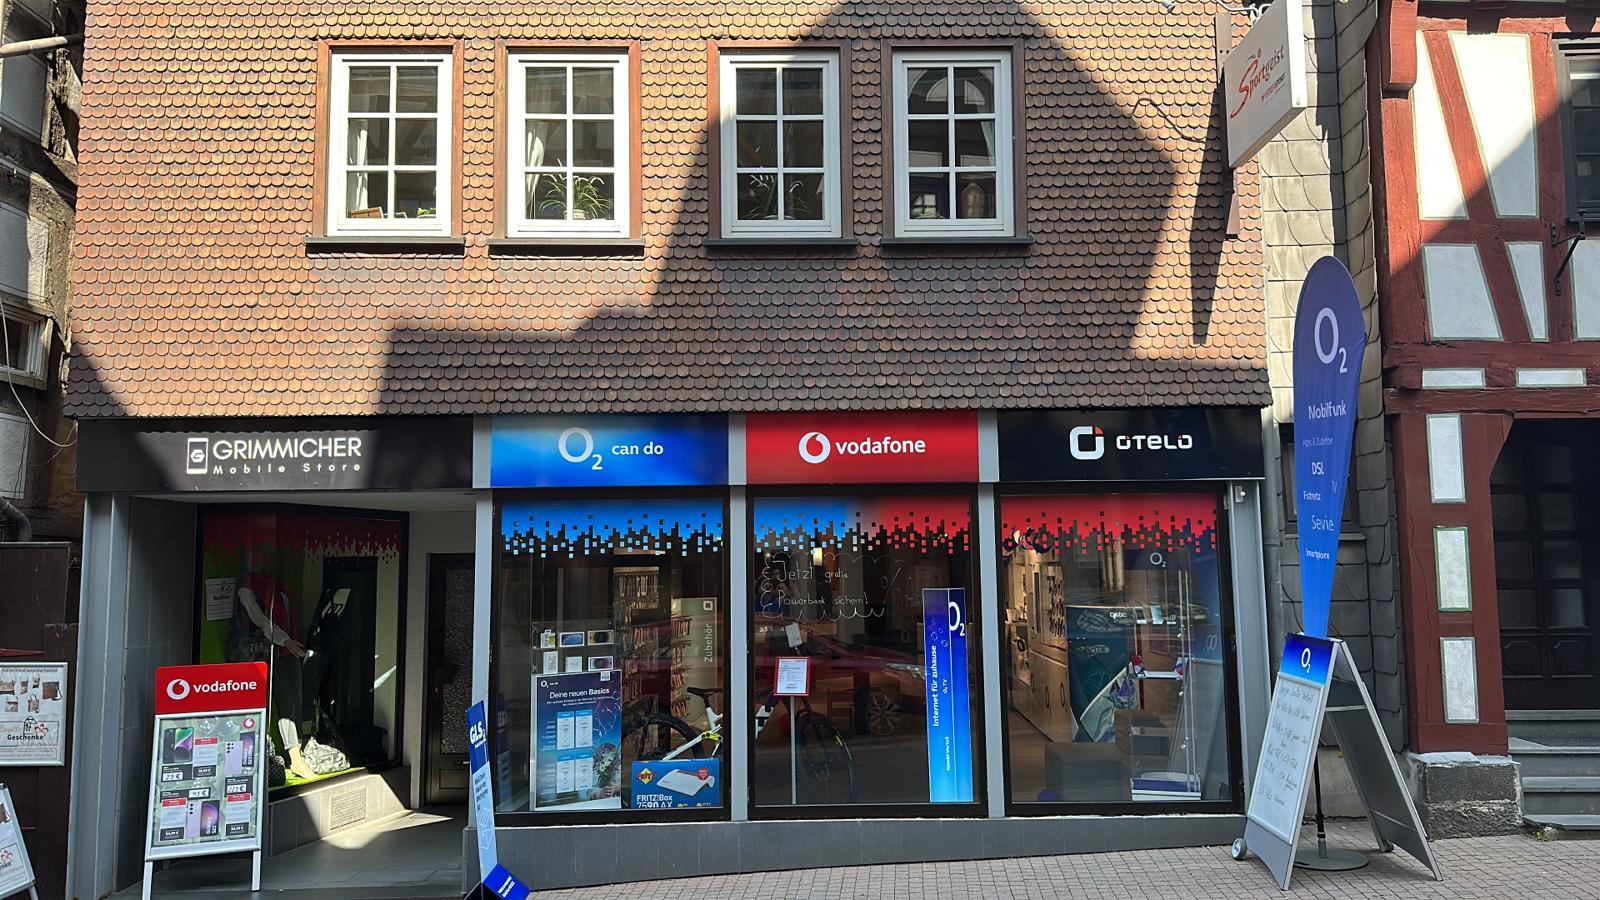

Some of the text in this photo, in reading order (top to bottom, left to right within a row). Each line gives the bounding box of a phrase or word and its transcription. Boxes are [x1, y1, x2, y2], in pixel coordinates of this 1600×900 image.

[1230, 45, 1284, 118] Sportgeist
[212, 437, 362, 460] GRIMMICHER
[611, 444, 639, 456] can
[643, 441, 664, 455] do
[835, 436, 926, 455] vodafone
[213, 462, 361, 475] Mobile Store
[1311, 461, 1325, 475] DSL
[772, 560, 848, 583] Jetzt gratis
[778, 589, 826, 609] Powerbank
[704, 624, 713, 663] Zubehör
[193, 680, 257, 693] vodafone
[549, 687, 610, 699] Deine neuen Basics
[930, 645, 940, 727] Internet für zuhause
[7, 733, 44, 741] Geschenke
[469, 720, 483, 744] GLS
